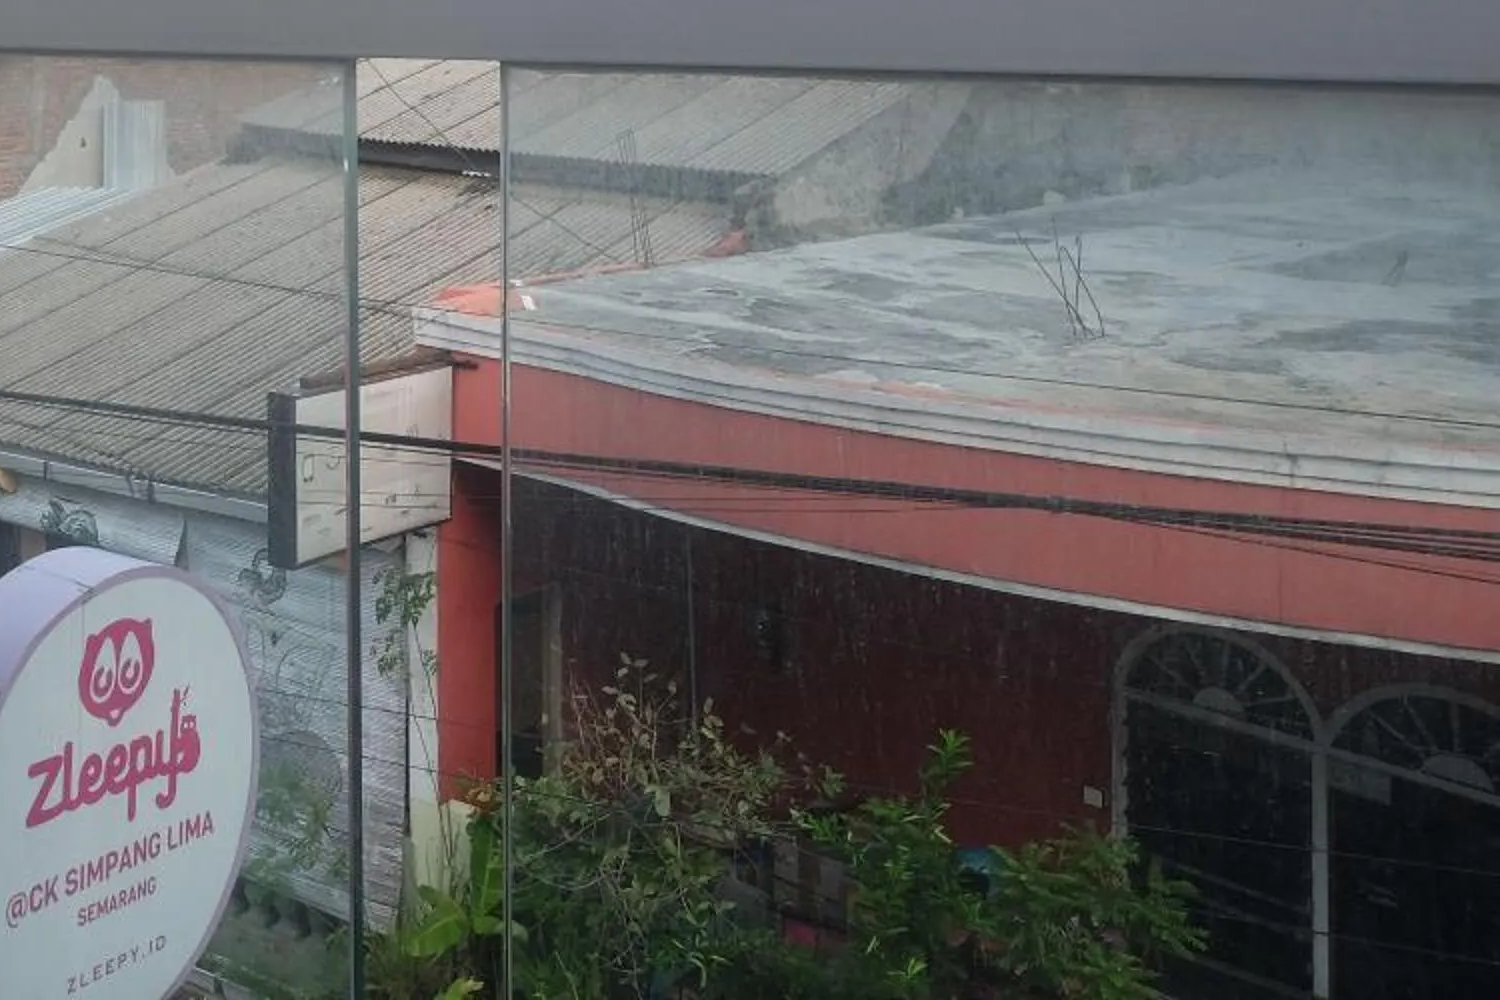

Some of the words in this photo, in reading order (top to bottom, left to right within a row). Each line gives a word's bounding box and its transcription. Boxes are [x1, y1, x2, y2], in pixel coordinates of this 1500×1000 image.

[5, 875, 59, 928] @CK
[64, 831, 161, 897] SIMPANG
[167, 811, 215, 849] LIMA
[76, 876, 157, 927] SEMARANG
